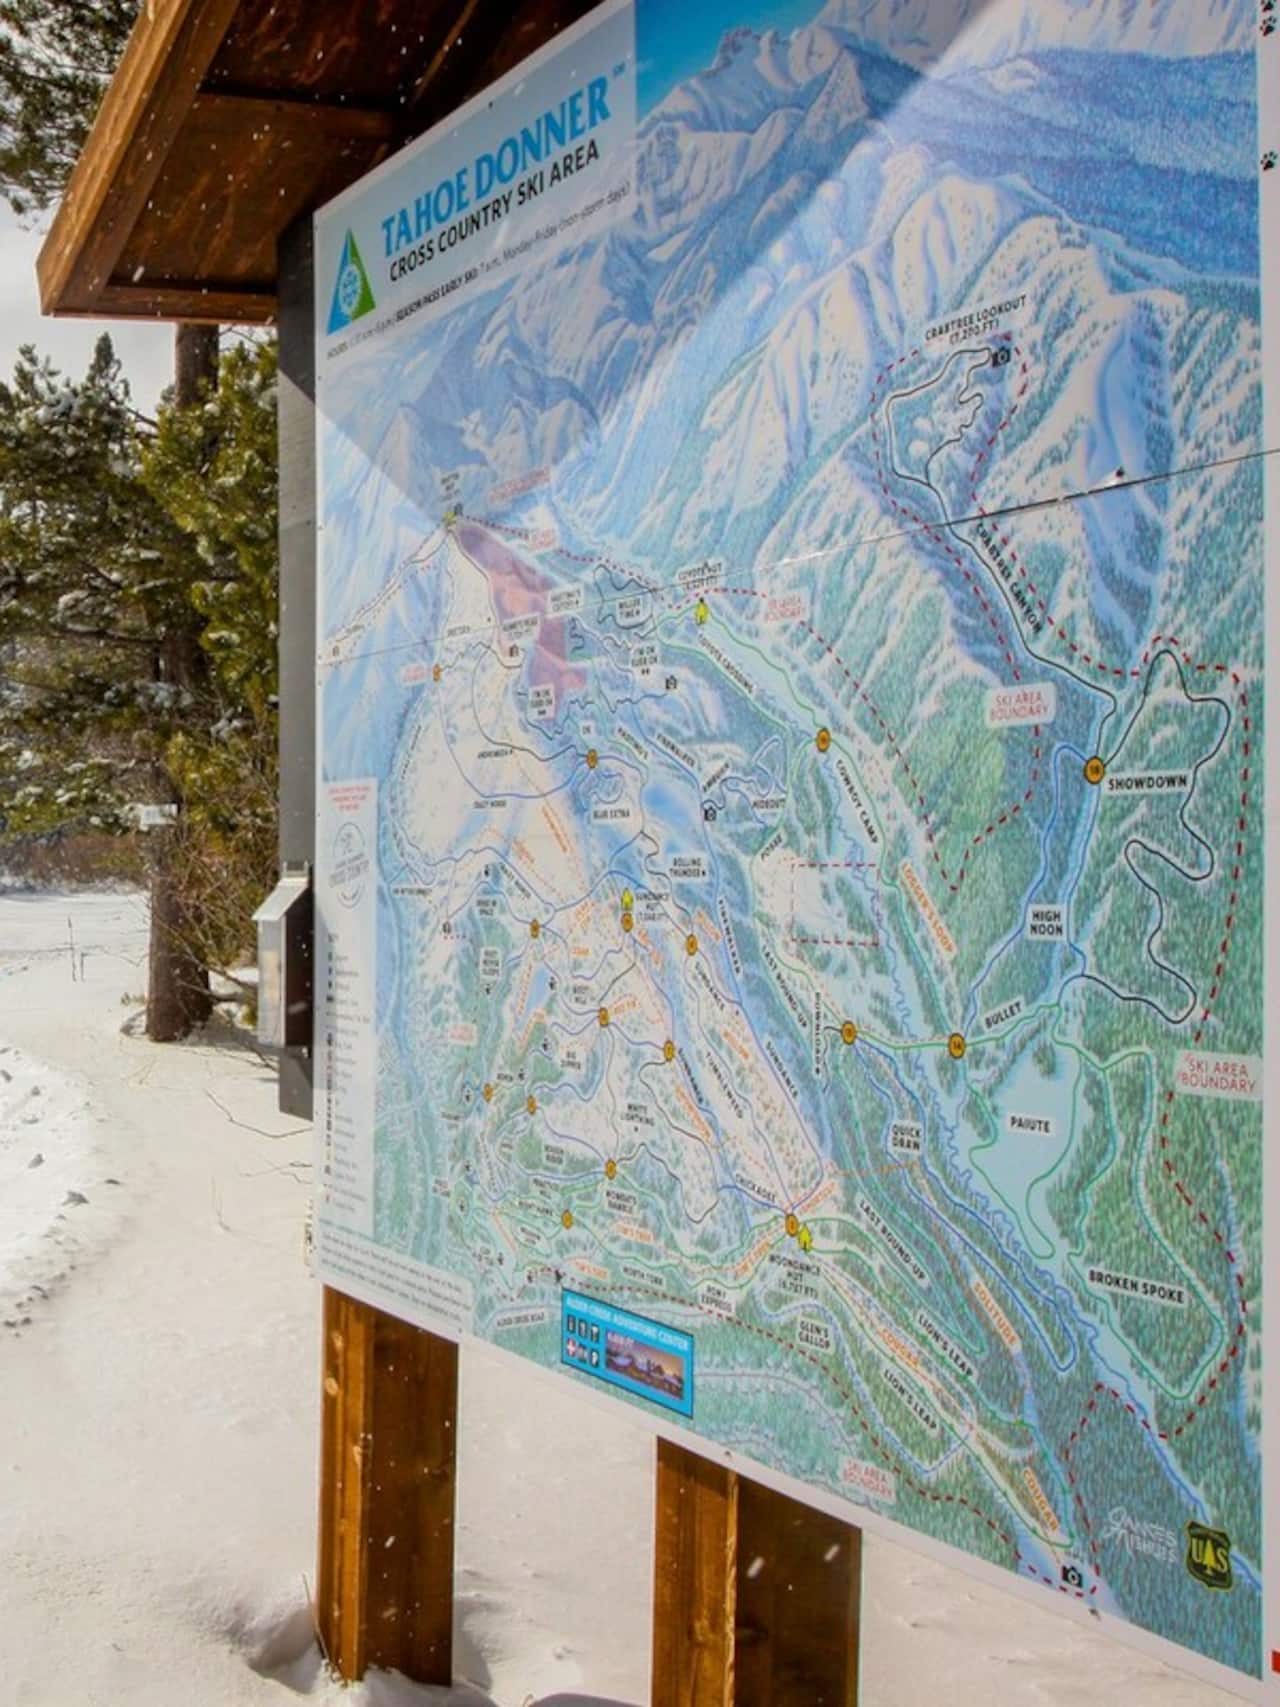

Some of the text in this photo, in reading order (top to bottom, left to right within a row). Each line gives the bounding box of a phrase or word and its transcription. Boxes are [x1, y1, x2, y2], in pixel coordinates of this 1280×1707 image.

[381, 76, 610, 258] TAHOE DONNER
[389, 139, 599, 282] CROSS COUNTRY SKI AREA
[925, 294, 1027, 341] CRABTREE LOOKOUT
[976, 523, 1043, 634] CRABTREE CANYON
[1108, 775, 1188, 791] SHOWDOWN
[859, 810, 879, 844] CAMP
[1030, 923, 1063, 936] NOON
[1031, 910, 1062, 923] HIGH
[984, 1002, 1023, 1028] BULLET
[1188, 1058, 1249, 1078] SKI AREA
[1180, 1071, 1257, 1093] BOUNDARY
[892, 1124, 922, 1137] QUICK
[1009, 1115, 1051, 1134] PAIUTE
[892, 1136, 920, 1150] DRAW
[859, 1199, 925, 1280] LAST ROUND-UP
[770, 1254, 821, 1274] MOONDANCE
[1088, 1269, 1185, 1304] BROKEN SPOKE
[974, 1282, 1018, 1346] SOLITUDE
[798, 1331, 831, 1350] GALLOP
[800, 1320, 829, 1338] GLEN'S
[918, 1314, 973, 1377] LION'S LEAP
[884, 1369, 937, 1429] LION'S LEAP
[1023, 1468, 1060, 1532] COUGAR
